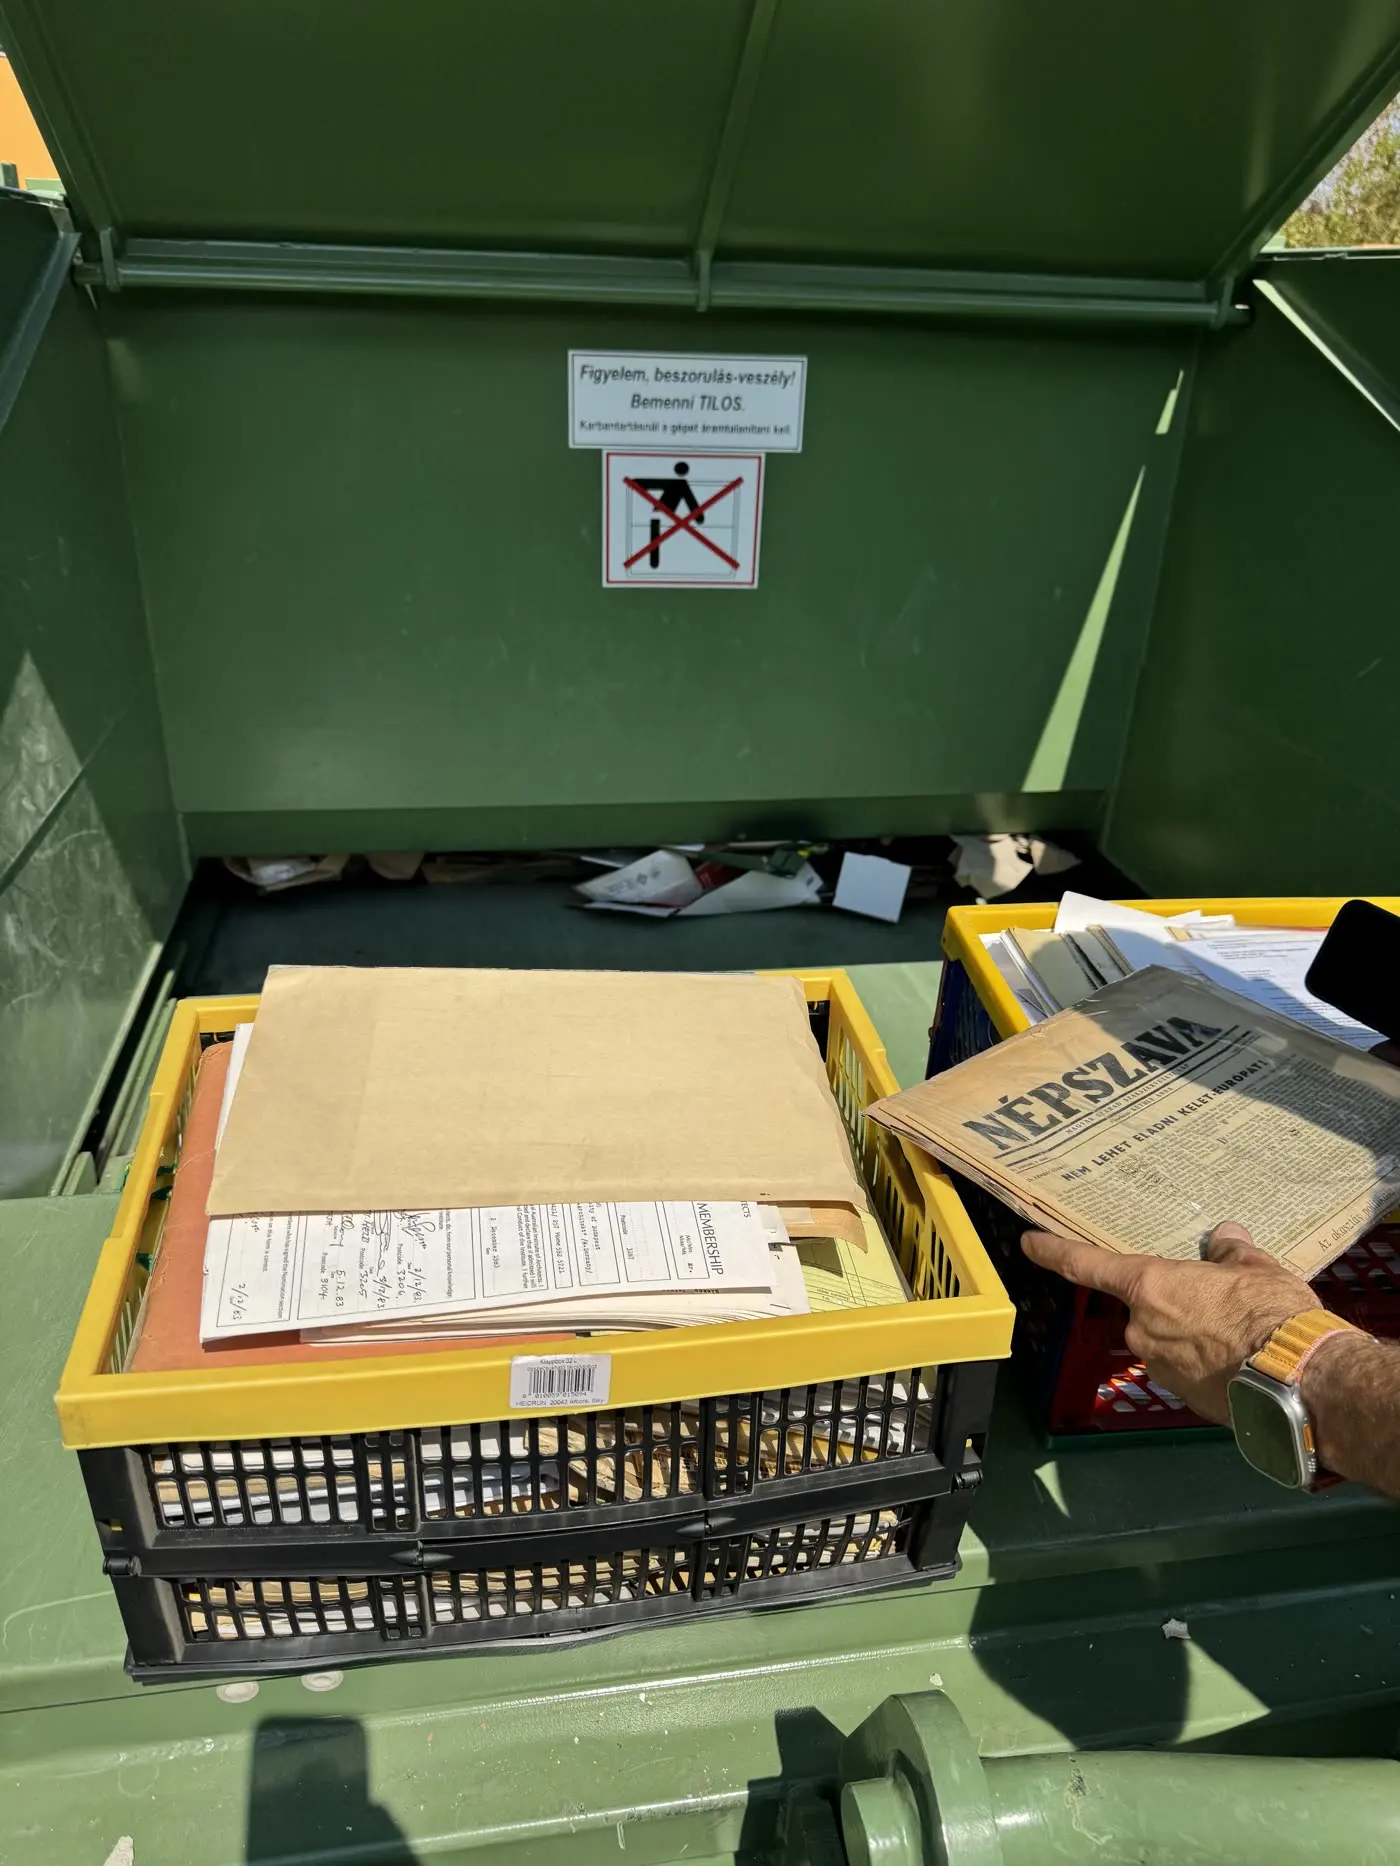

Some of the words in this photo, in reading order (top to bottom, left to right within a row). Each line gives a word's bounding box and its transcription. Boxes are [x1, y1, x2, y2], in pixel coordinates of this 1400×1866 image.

[654, 366, 796, 390] beszorulás-veszély!
[630, 393, 695, 410] Bemenni
[961, 1016, 1222, 1151] NÉPSZAVA
[1061, 1165, 1092, 1182] NEM
[1091, 1140, 1130, 1167] LEHET
[1133, 1115, 1179, 1142] ELADNI
[1177, 1058, 1269, 1116] KELET-EURÓPÁT!
[696, 1202, 724, 1275] MEMBERSHIP
[1317, 1239, 1332, 1252] Az
[1331, 1213, 1364, 1241] akasztás
[282, 1248, 290, 1264] signed
[320, 1252, 328, 1274] Postcode
[280, 1271, 288, 1300] Nomination
